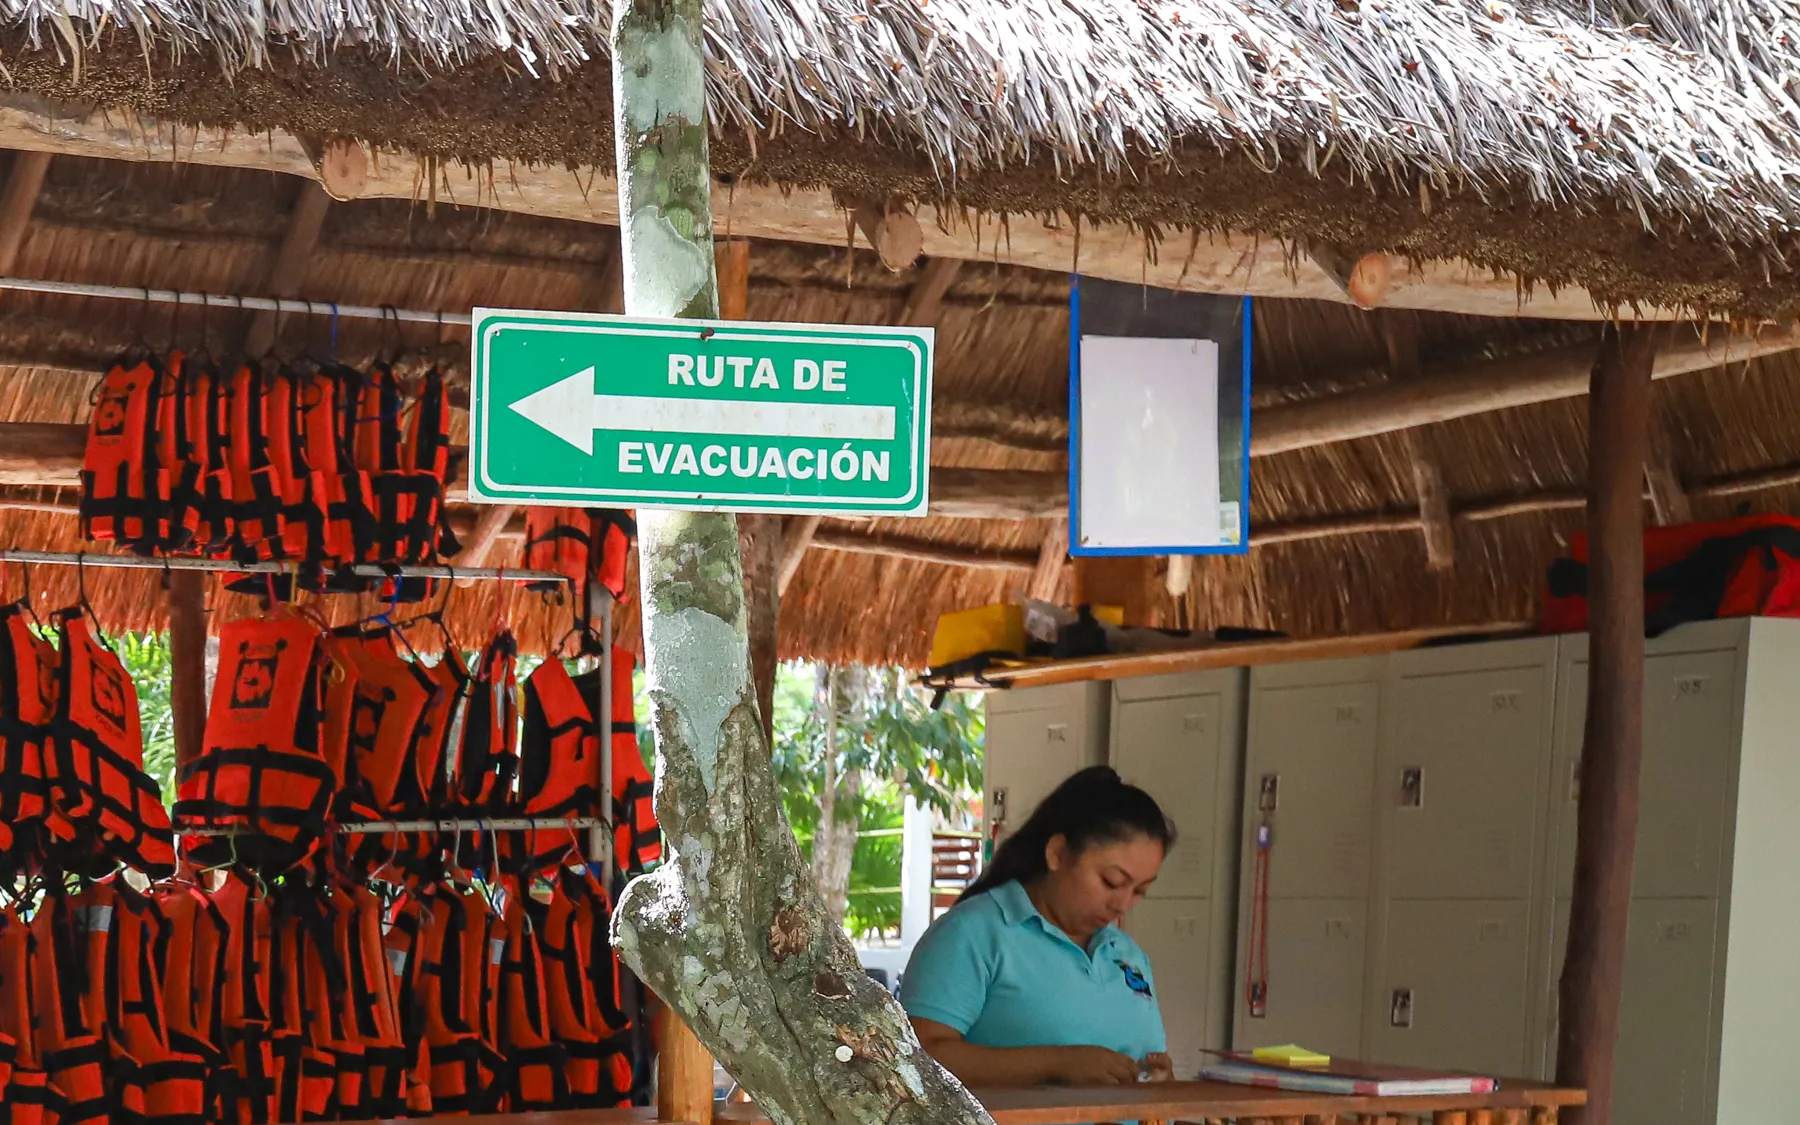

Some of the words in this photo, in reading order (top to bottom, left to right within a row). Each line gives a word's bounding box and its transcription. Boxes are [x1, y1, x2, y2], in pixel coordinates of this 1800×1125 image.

[668, 353, 780, 389] RUTA
[793, 359, 847, 392] DE
[618, 441, 890, 482] EVACUACIÓN
